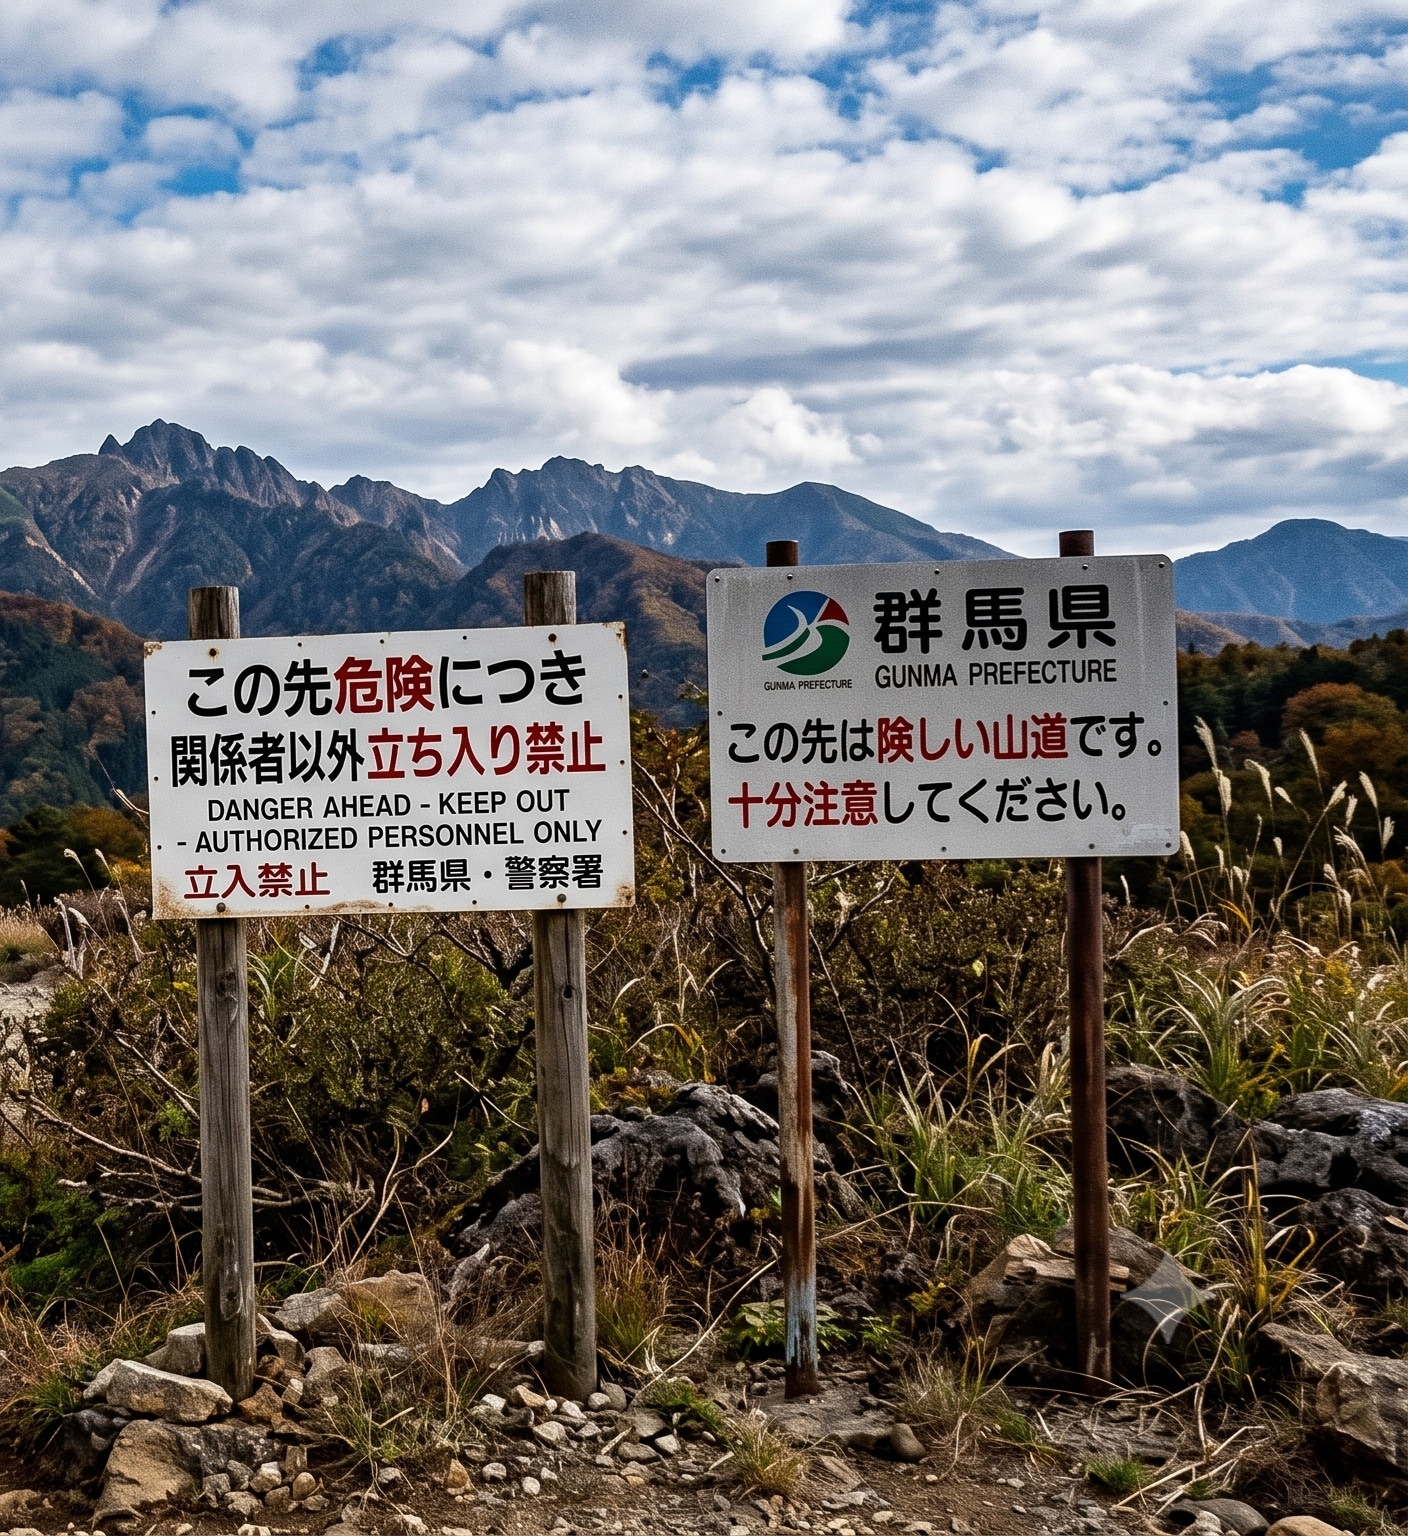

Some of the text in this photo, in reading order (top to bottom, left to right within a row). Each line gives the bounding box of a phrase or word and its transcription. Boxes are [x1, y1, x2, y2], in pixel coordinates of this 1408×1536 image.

[872, 583, 1117, 655] 群馬県
[187, 649, 586, 718] この先危険につき
[763, 678, 853, 692] GUNMA PREFECTURE
[874, 658, 1118, 689] GUNMA PREFECTURE
[170, 720, 606, 788] 関係者以外立ち入り禁止
[728, 710, 1162, 765] この先は険しい山道です。
[208, 797, 313, 822] DANGER
[322, 793, 411, 819] AHEAD
[439, 791, 507, 815] KEEP
[516, 788, 570, 813] OUT
[727, 775, 1126, 829] 十分注意してください。
[195, 826, 358, 853] AUTHORIZED
[368, 821, 524, 849] PERSONNEL
[533, 819, 603, 844] ONLY
[183, 854, 604, 900] 立入禁止 群馬県・警察署
